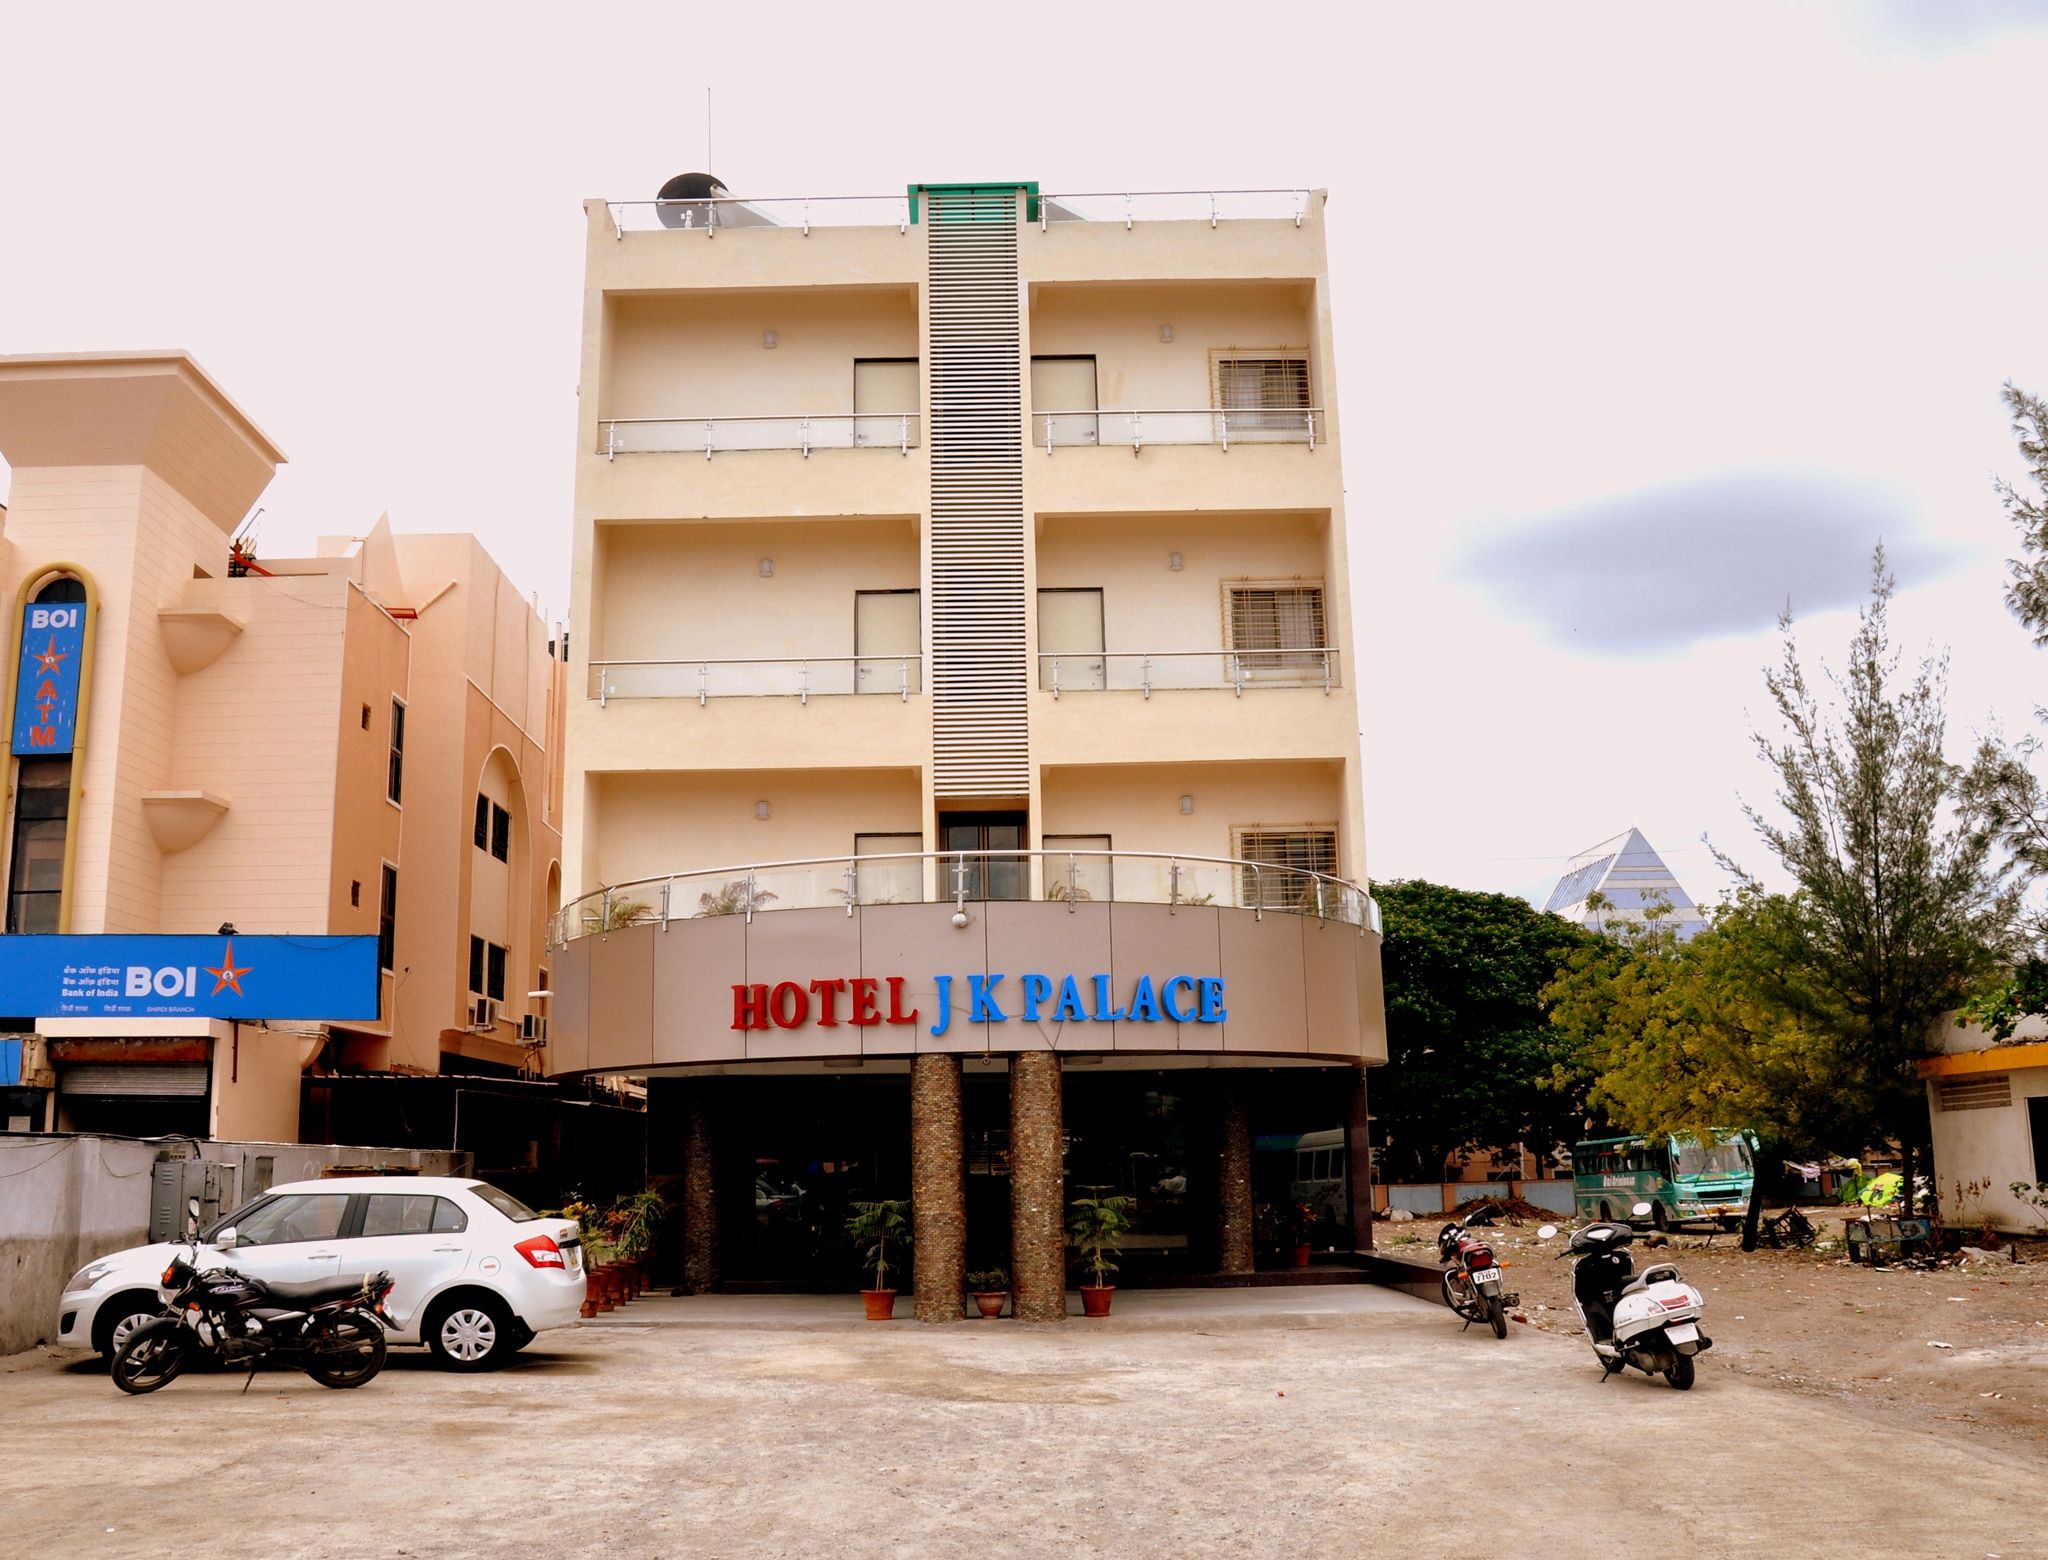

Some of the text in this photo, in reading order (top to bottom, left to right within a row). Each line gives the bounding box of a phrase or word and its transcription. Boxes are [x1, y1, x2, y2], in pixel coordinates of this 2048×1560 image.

[32, 609, 77, 628] BOI
[31, 679, 58, 746] ATM
[62, 989, 119, 997] Bank of India
[125, 966, 197, 997] BOI
[731, 974, 1227, 1036] HOTEL J K PALACE
[1476, 1271, 1497, 1282] 7702
